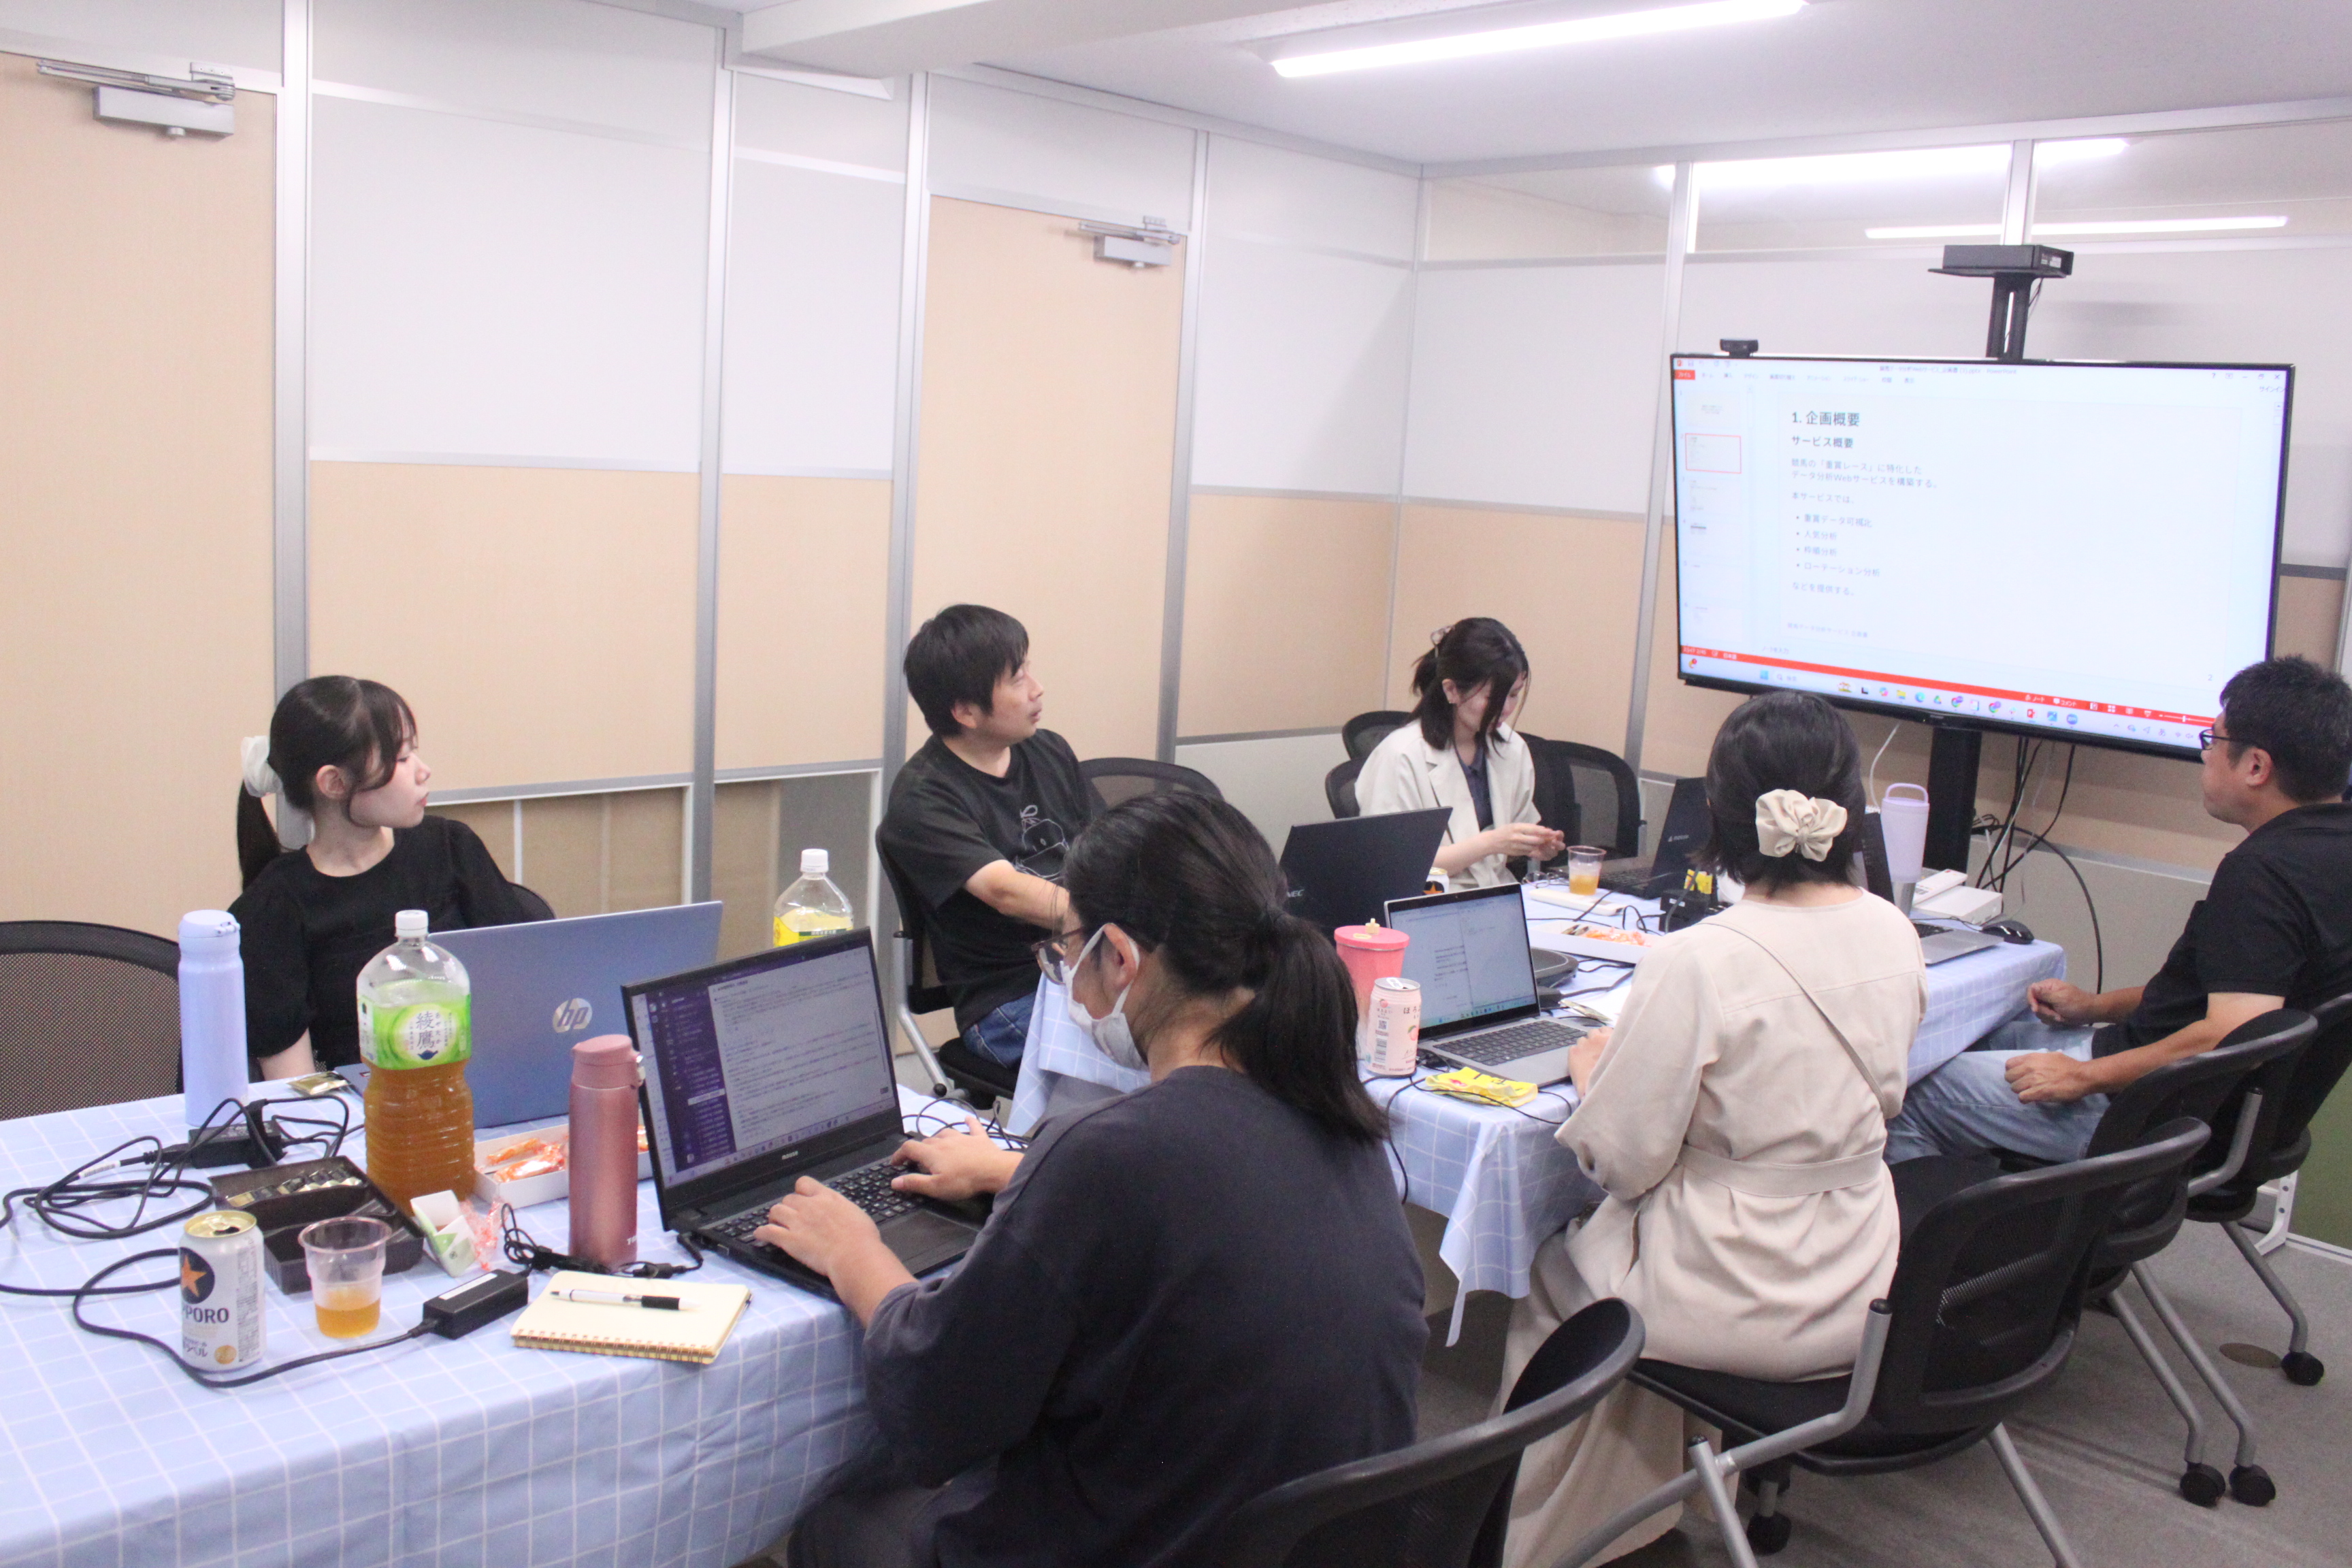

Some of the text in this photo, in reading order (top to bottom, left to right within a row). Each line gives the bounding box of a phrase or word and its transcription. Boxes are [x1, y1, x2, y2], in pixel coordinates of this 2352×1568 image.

[1791, 410, 1860, 427] 1. 企画概要
[1791, 435, 1854, 449] サービス概要
[1804, 562, 1880, 578] ローテーション分析
[555, 998, 591, 1032] hp
[416, 1011, 435, 1049] 綾鷹
